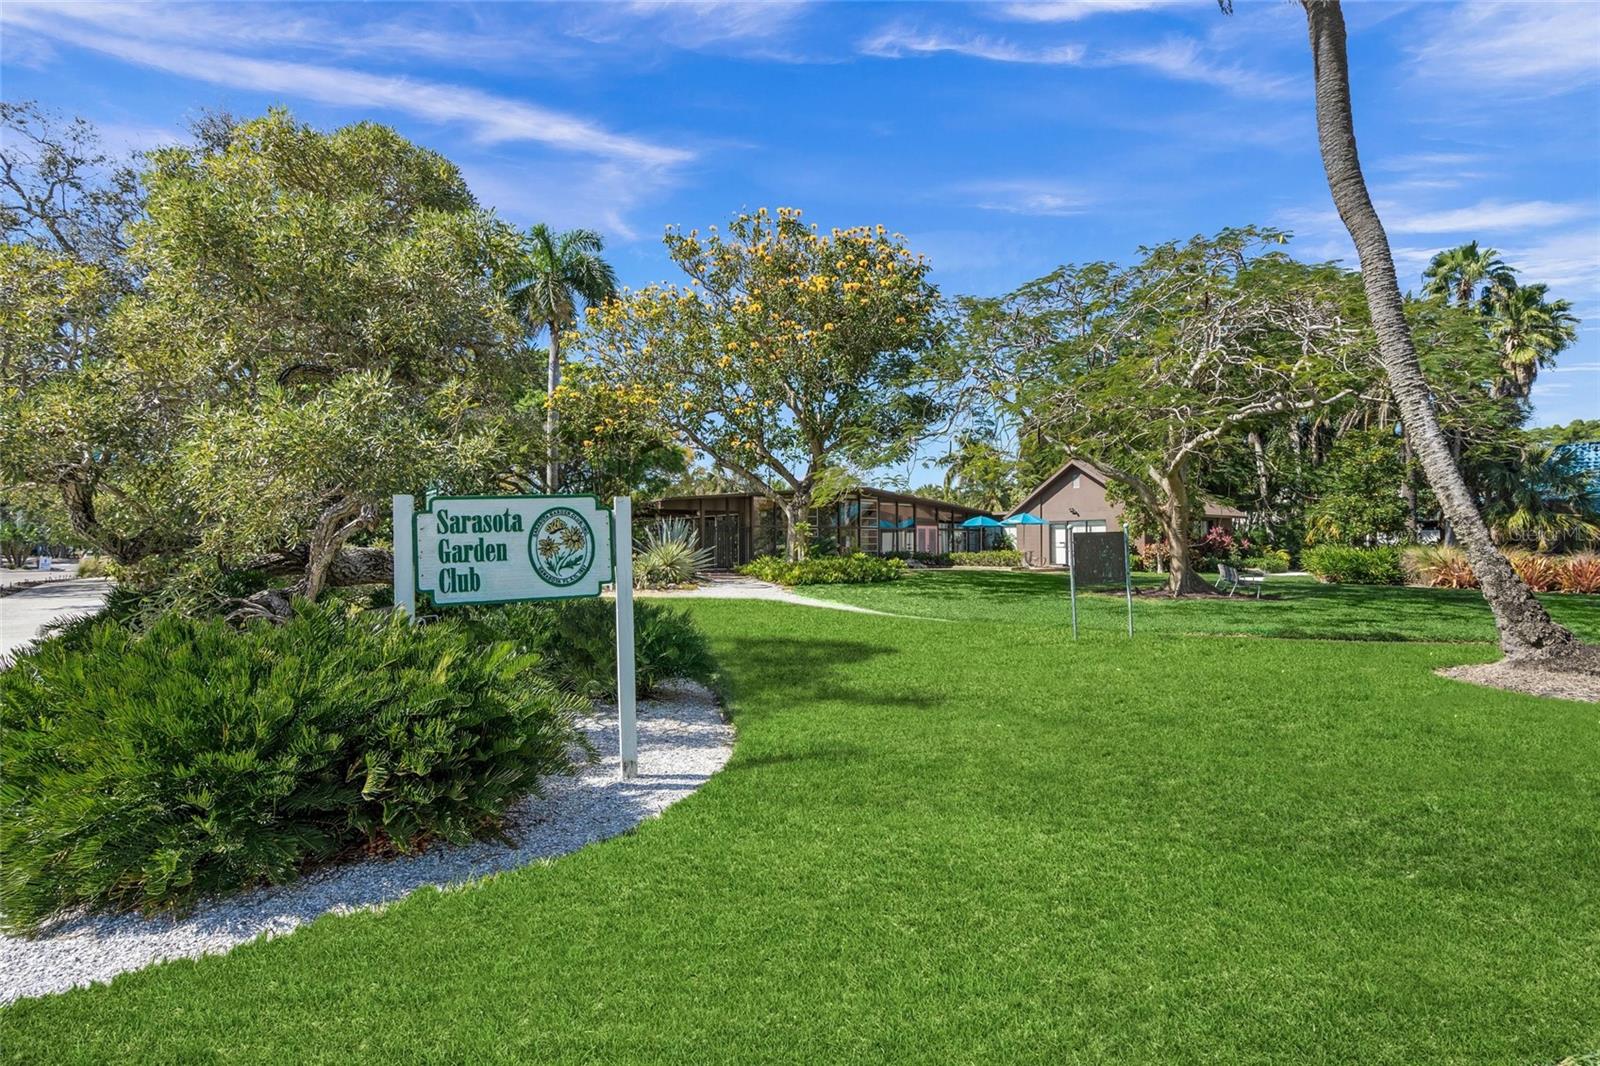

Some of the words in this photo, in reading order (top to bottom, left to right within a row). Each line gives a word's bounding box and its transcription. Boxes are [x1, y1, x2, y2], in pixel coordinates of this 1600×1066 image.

[436, 508, 524, 534] Sarasota
[438, 537, 508, 564] Garden
[438, 567, 482, 594] Club
